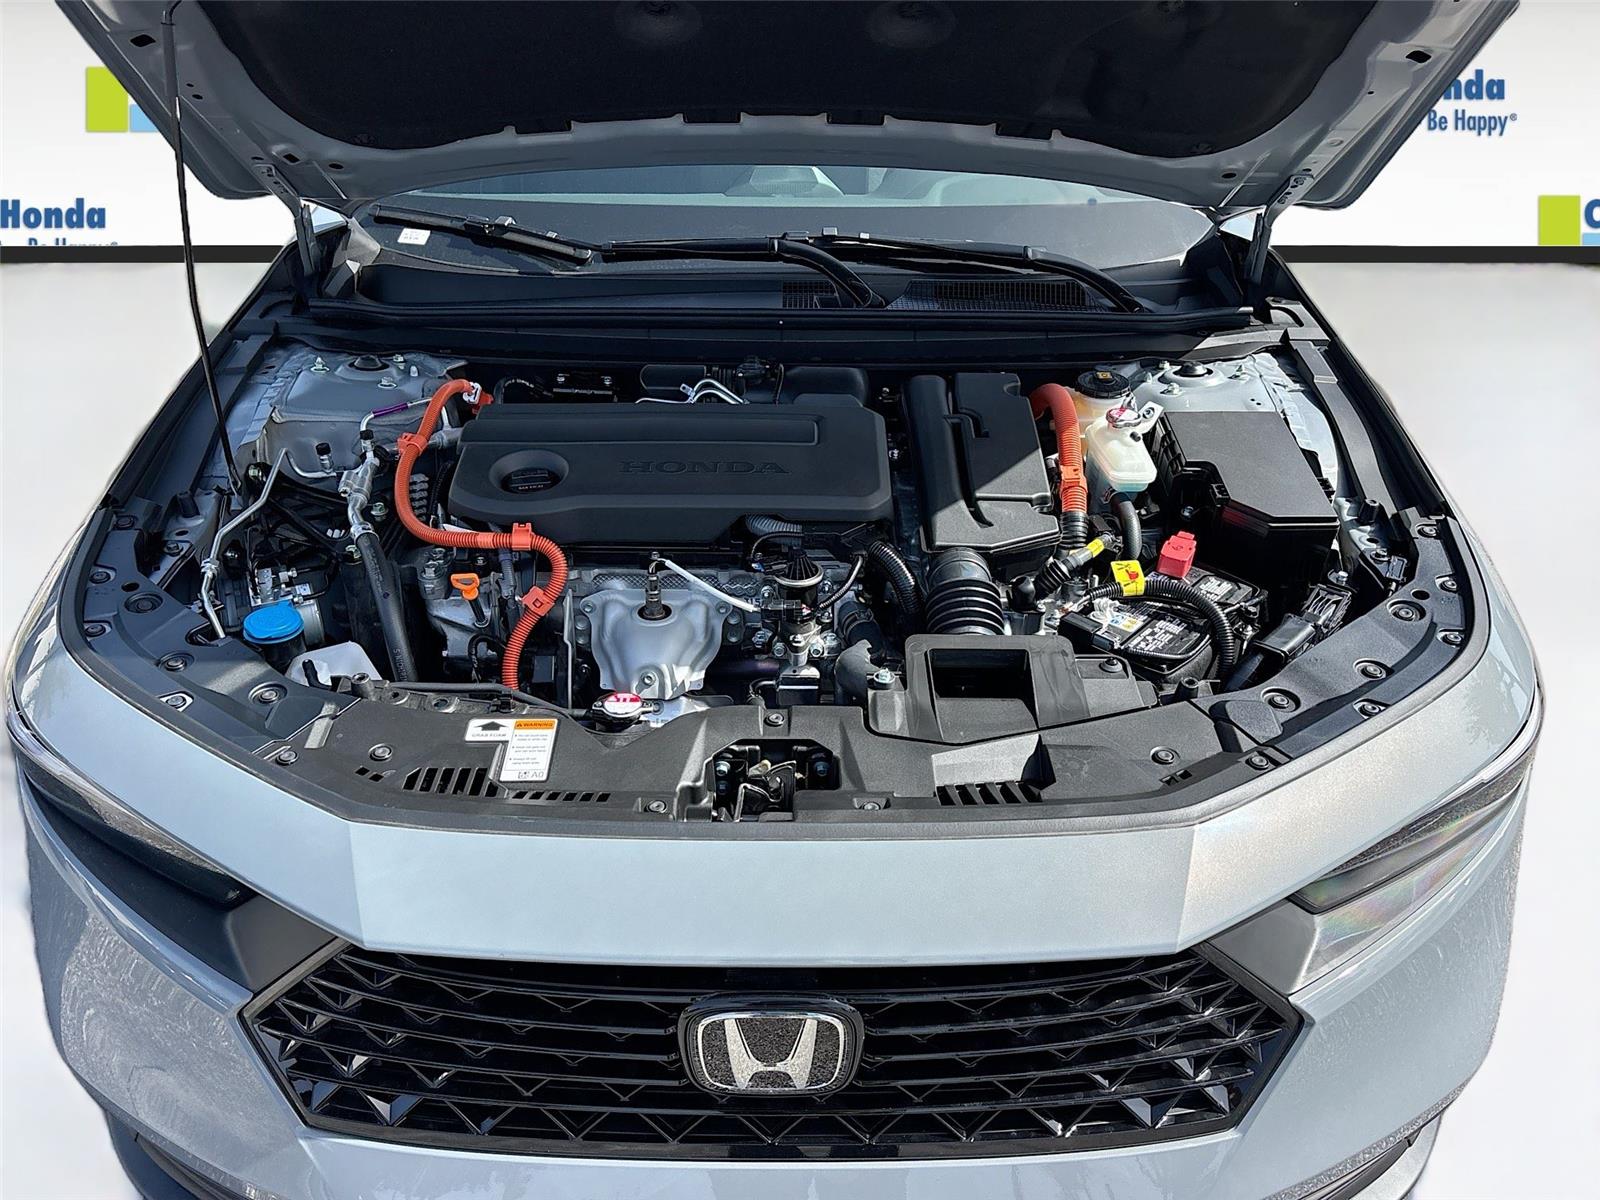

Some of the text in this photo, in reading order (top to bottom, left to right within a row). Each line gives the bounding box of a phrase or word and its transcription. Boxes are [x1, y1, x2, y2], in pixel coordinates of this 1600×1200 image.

[1443, 69, 1505, 100] nda
[1427, 109, 1448, 131] Be
[0, 197, 106, 229] Honda
[618, 460, 790, 475] HONDA
